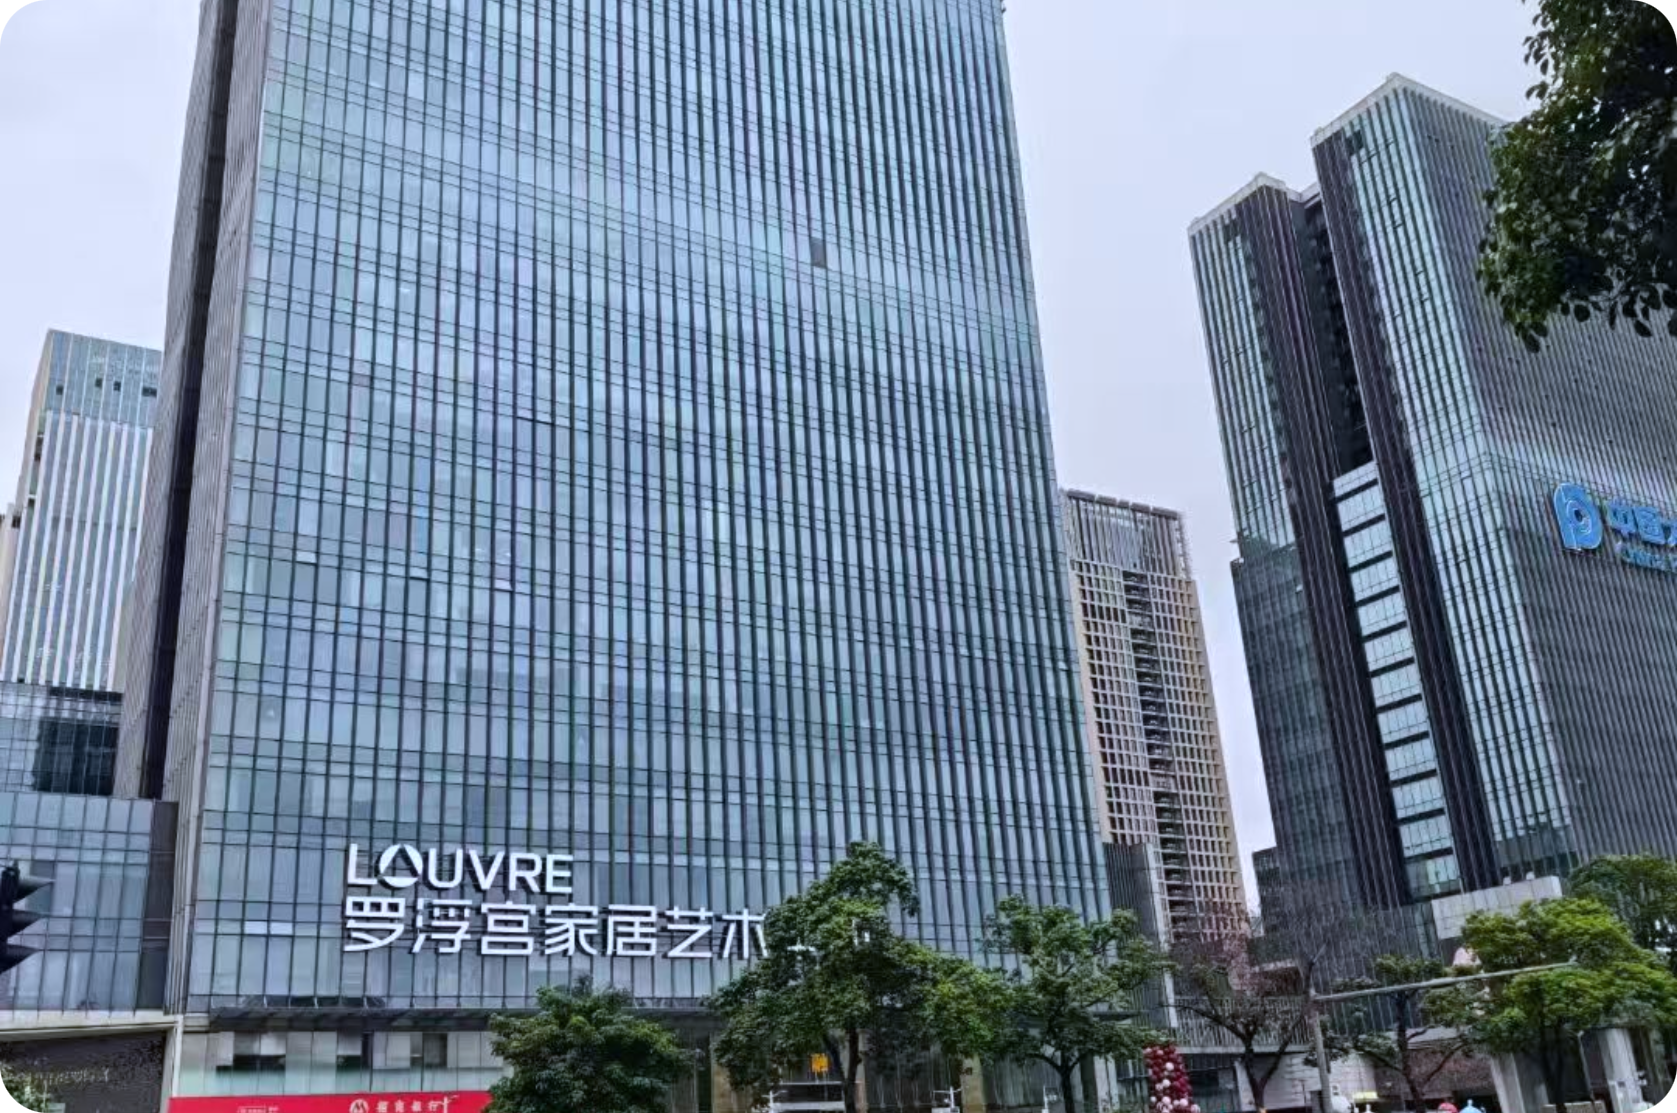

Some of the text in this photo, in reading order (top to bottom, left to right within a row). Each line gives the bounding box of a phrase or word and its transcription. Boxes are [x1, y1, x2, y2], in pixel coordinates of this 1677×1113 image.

[1605, 500, 1677, 546] 中国
[347, 843, 574, 894] LOUVRE
[343, 896, 870, 967] 罗浮宫家居艺术
